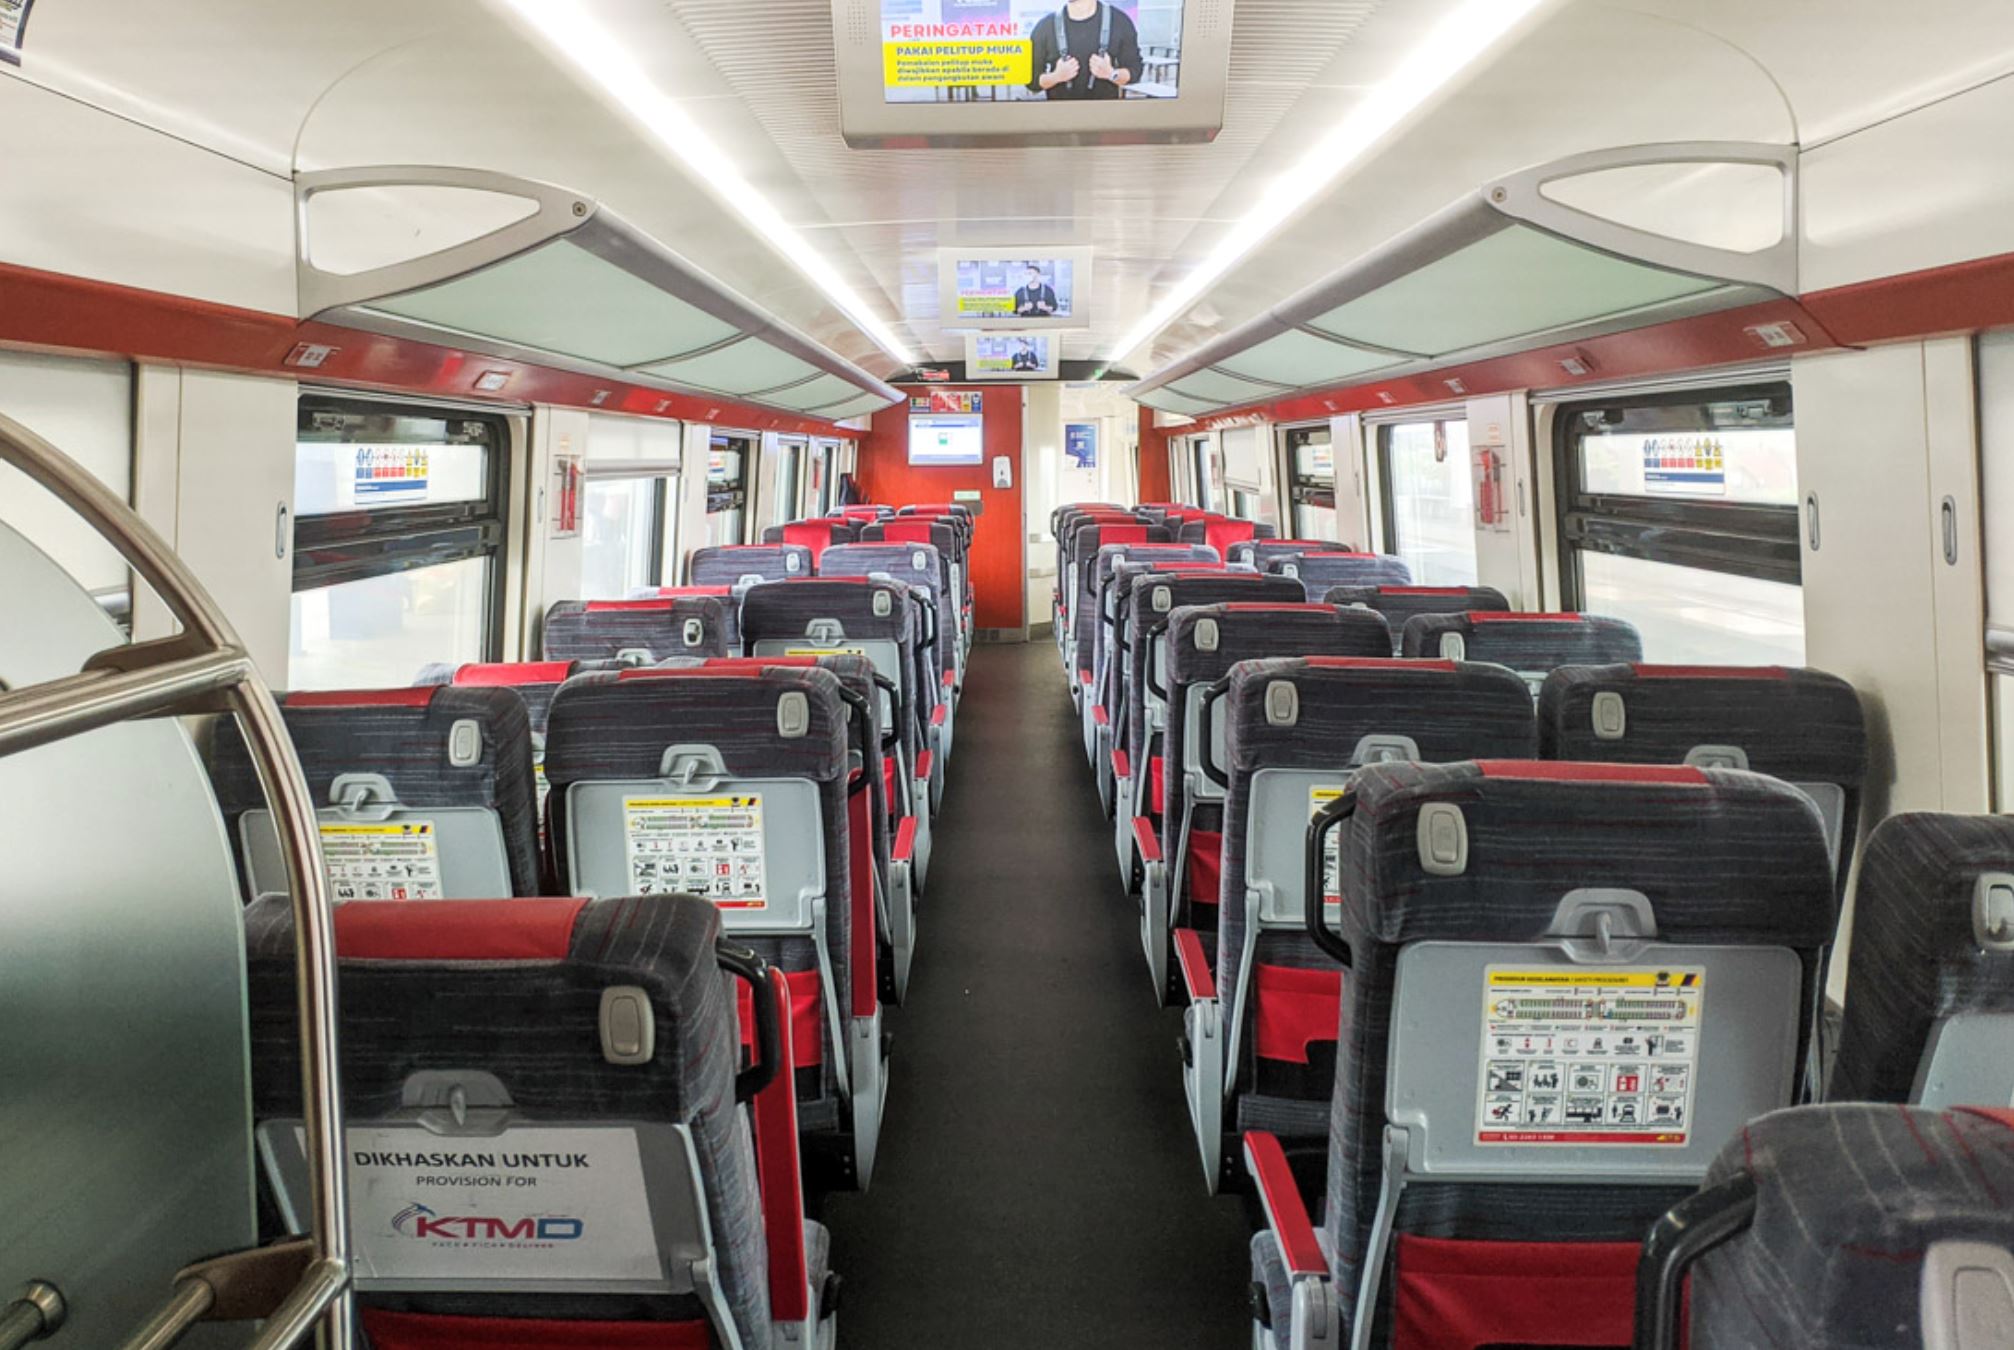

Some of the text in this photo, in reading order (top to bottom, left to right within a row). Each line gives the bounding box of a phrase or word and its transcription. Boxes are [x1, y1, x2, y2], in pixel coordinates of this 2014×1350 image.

[890, 22, 1019, 38] PERINGATAN!
[896, 45, 1022, 56] PAKAI PELITUP MUKA
[354, 1151, 590, 1168] DIKHASKAN UNTUK
[416, 1175, 537, 1187] PROVISION FOR
[416, 1215, 584, 1240] KTMD
